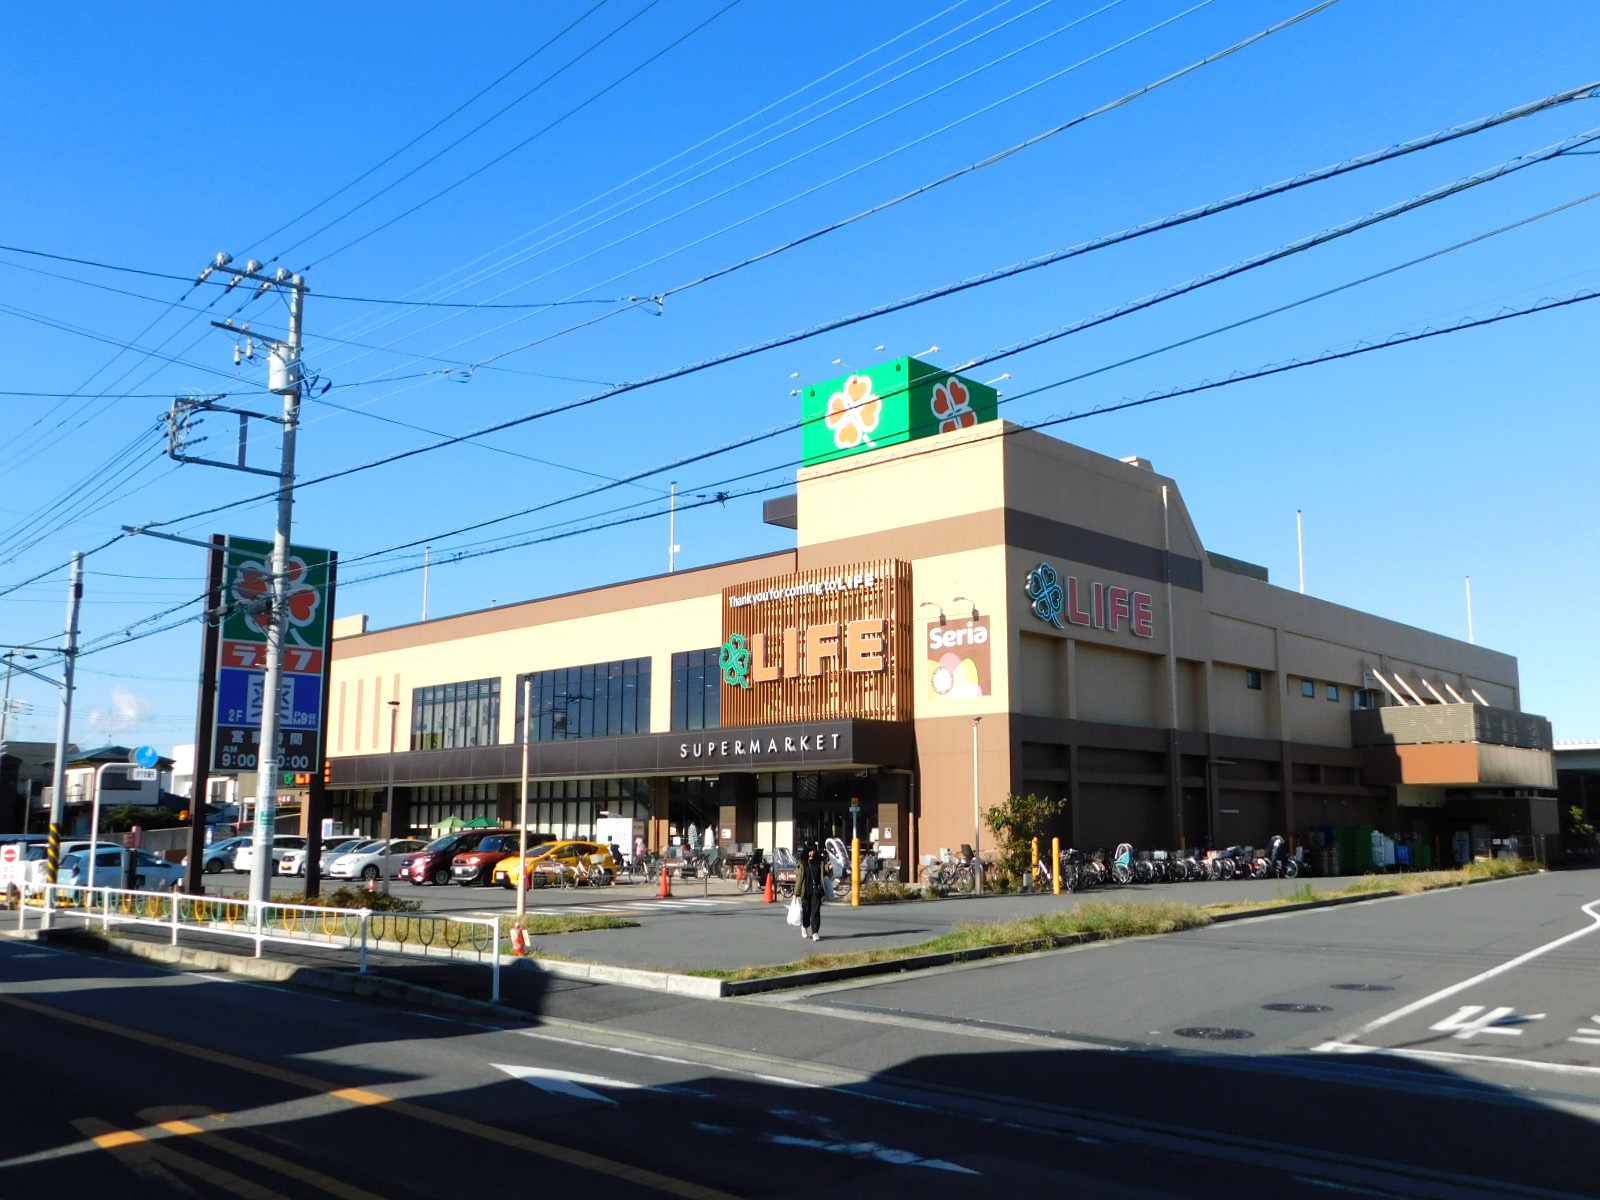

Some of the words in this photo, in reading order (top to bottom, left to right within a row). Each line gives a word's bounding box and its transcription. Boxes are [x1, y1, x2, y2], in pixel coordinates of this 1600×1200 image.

[728, 592, 752, 608] Thank
[752, 592, 769, 606] you
[769, 587, 784, 600] for
[784, 582, 822, 598] coming
[824, 579, 837, 592] to
[837, 572, 875, 591] LIFE
[1063, 575, 1153, 639] LIFE
[929, 621, 988, 650] Seria
[232, 645, 313, 671] ラフ
[752, 618, 885, 683] LIFE
[228, 709, 243, 722] 2F
[223, 745, 238, 753] AM
[680, 733, 839, 759] SUPERMARKET
[222, 753, 256, 767] 9:00
